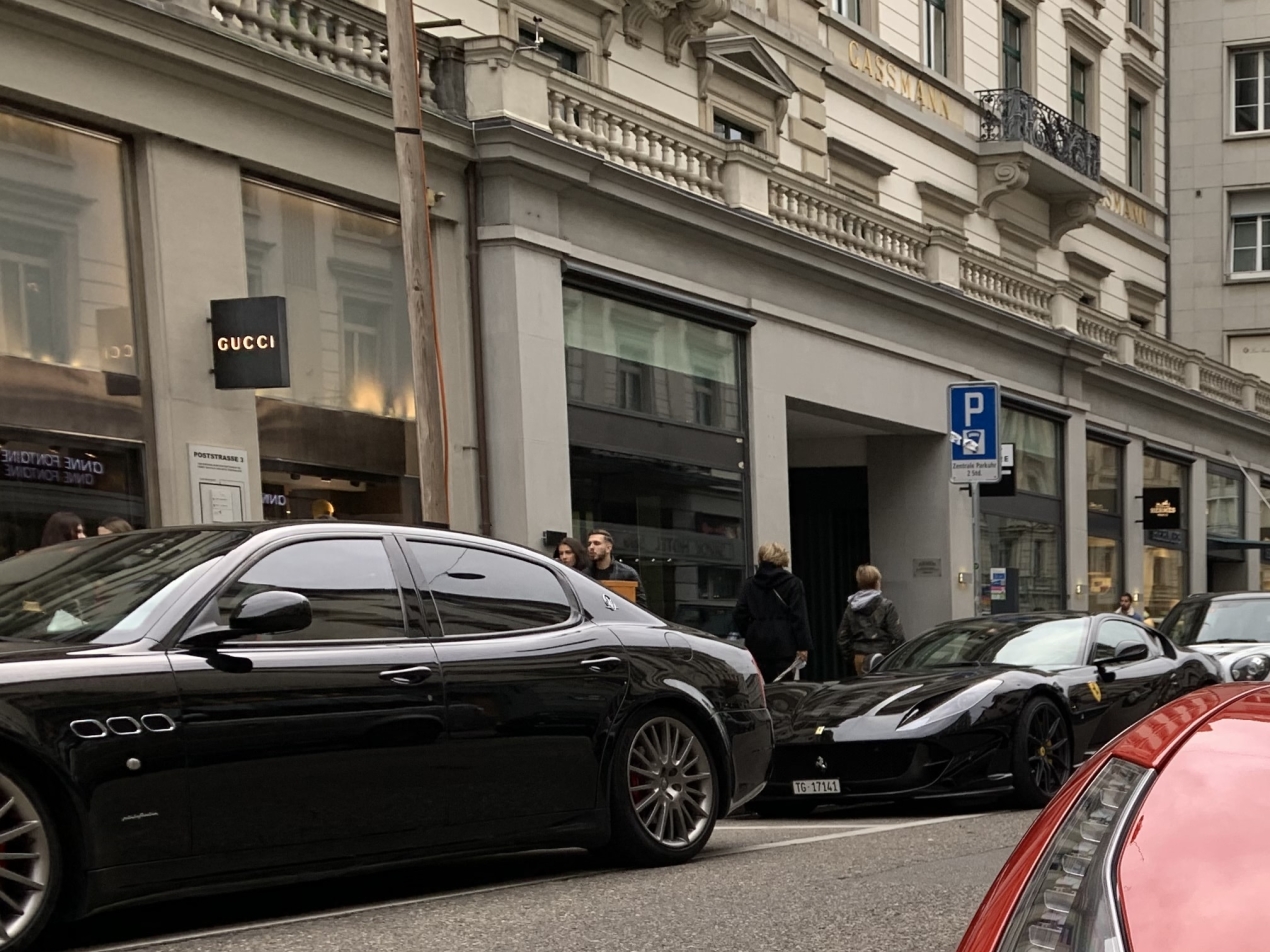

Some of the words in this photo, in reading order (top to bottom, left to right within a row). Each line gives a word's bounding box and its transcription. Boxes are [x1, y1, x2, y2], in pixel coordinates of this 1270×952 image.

[217, 335, 275, 351] GUCCI
[965, 392, 984, 427] P
[193, 451, 239, 462] POSTSTRASSE
